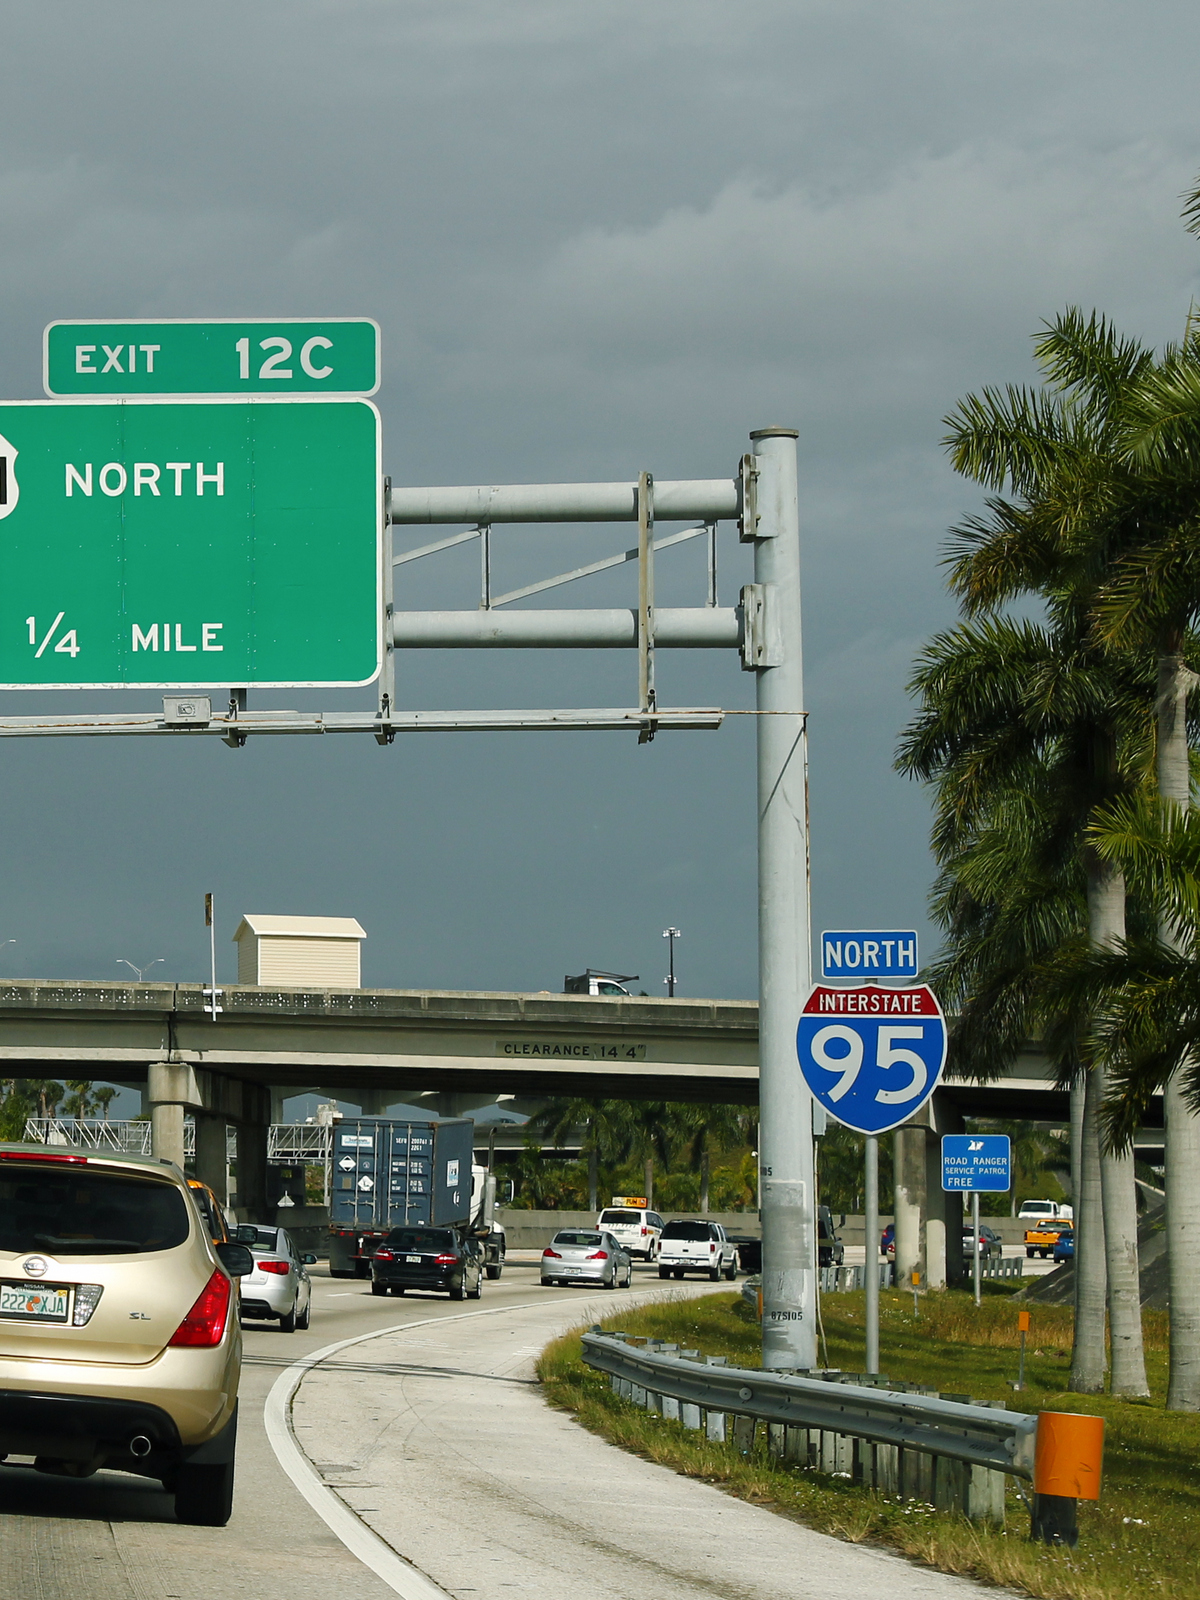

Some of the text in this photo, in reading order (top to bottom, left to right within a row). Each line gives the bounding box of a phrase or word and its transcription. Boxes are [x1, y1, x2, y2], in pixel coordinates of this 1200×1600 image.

[74, 335, 335, 380] EXIT 12C
[64, 461, 225, 498] NORTH
[131, 622, 224, 652] MILE
[825, 939, 915, 968] NORTH
[819, 993, 922, 1012] INTERSTATE
[504, 1043, 590, 1056] CLEARANCE
[810, 1024, 928, 1105] 95
[944, 1157, 1008, 1166] ROAD RANGER
[945, 1167, 1007, 1175] SERVICE PATROL
[947, 1177, 973, 1187] FREE
[1, 1292, 64, 1314] 222 XJA
[128, 1311, 152, 1320] SL
